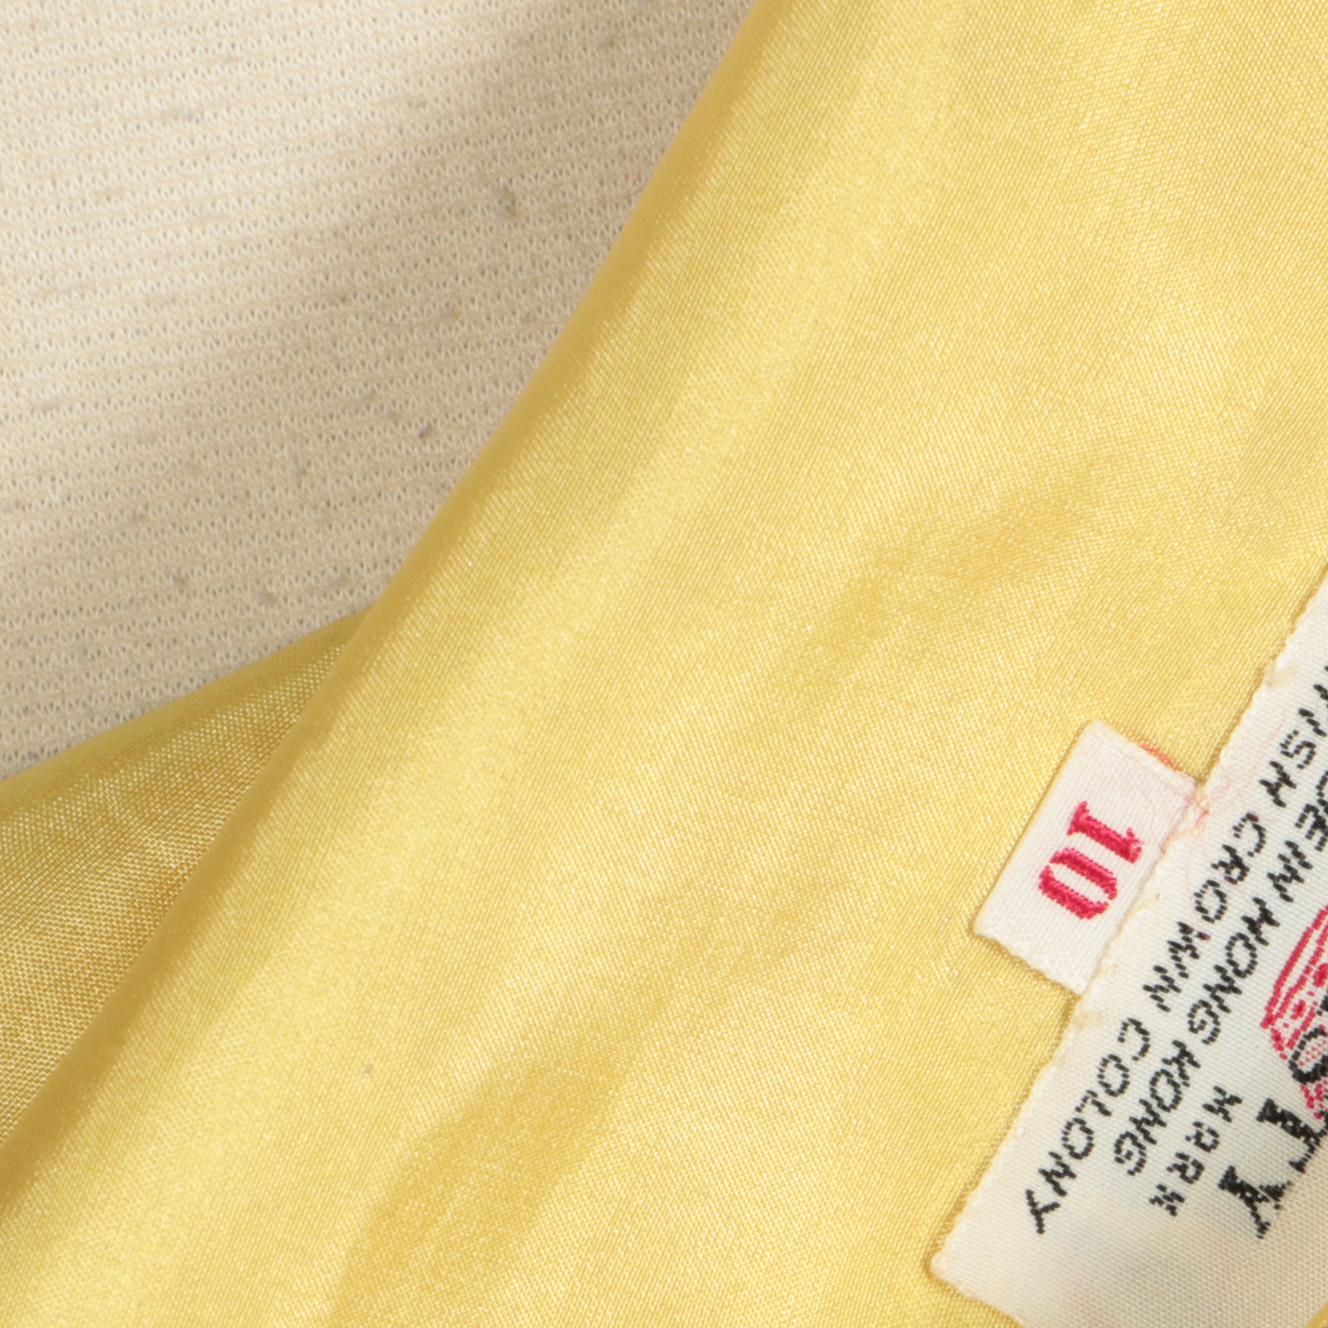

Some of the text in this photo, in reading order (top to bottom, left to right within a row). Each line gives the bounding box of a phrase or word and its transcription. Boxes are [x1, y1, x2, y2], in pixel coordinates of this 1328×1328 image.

[1037, 799, 1144, 922] 10
[1141, 811, 1267, 1013] CROWN
[1265, 838, 1314, 904] IN
[1185, 895, 1281, 1046] HONG
[1023, 1016, 1151, 1235] COLONY
[1112, 1038, 1202, 1177] KONG
[1147, 1084, 1244, 1218] MARK
